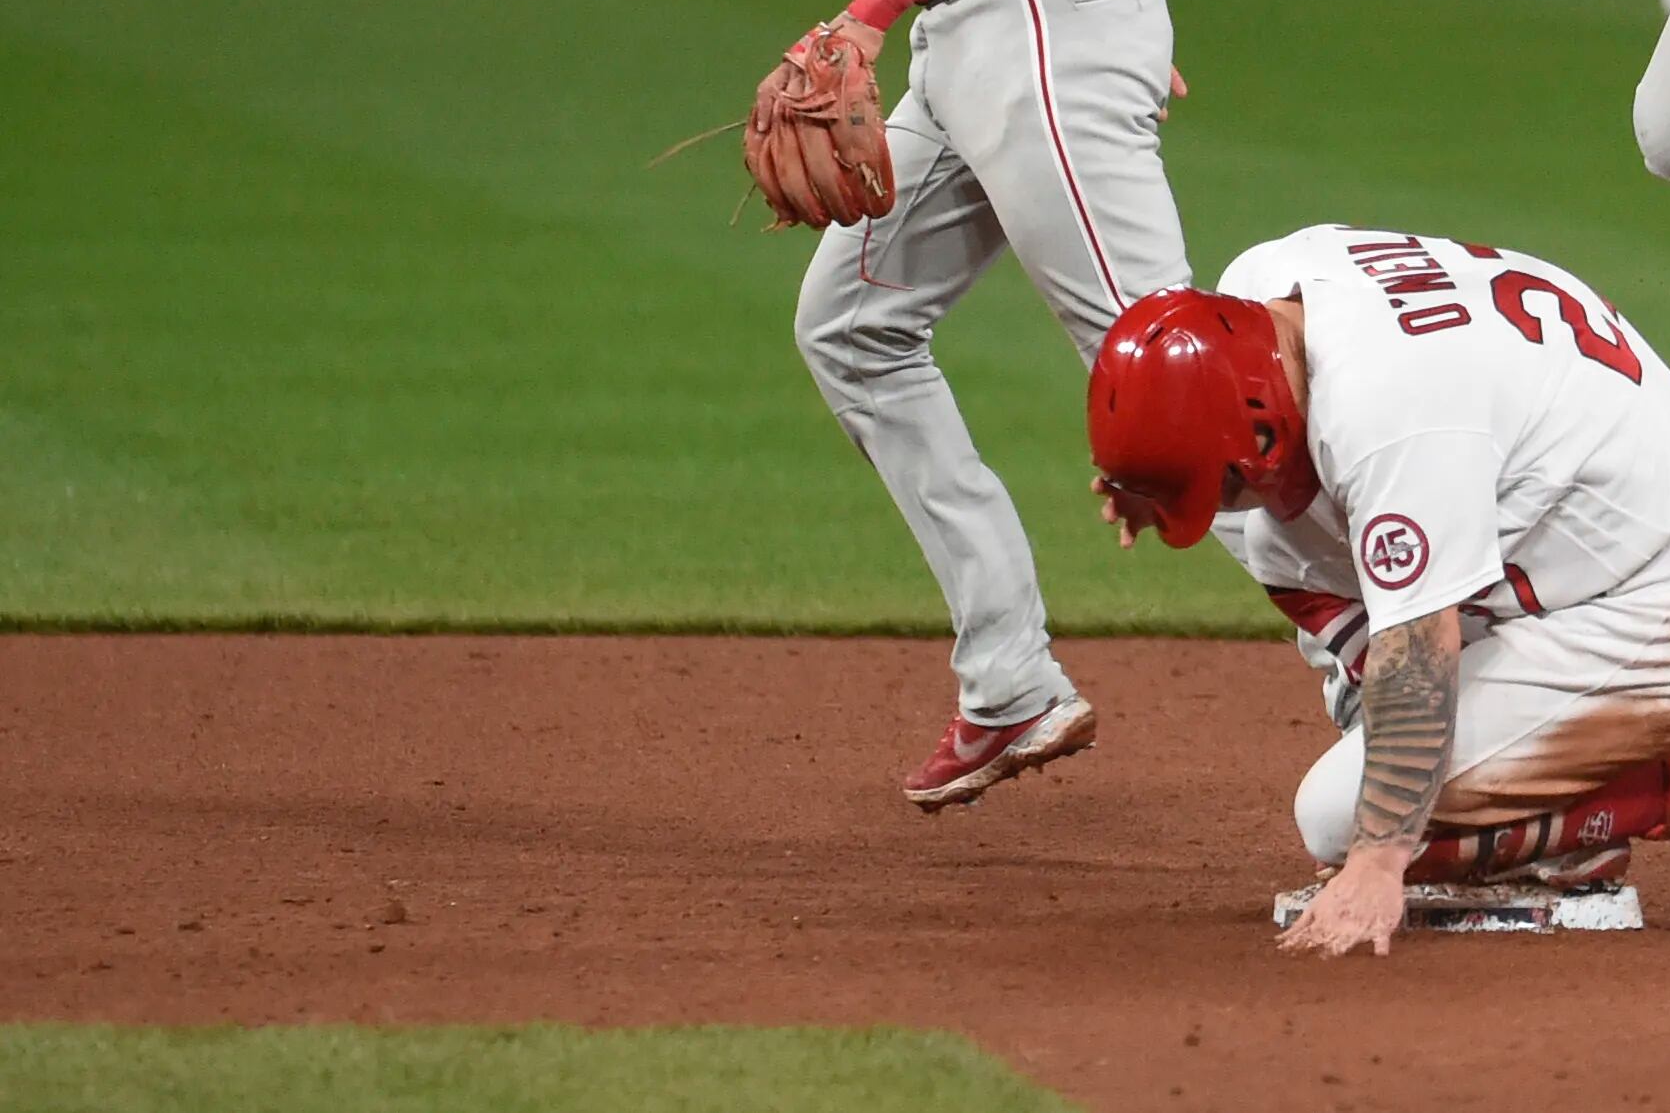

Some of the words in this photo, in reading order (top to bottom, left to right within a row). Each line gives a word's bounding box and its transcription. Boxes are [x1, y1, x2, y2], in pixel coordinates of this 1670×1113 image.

[1336, 227, 1473, 337] O'NEIL
[1465, 244, 1643, 387] 2
[1371, 527, 1415, 574] 45
